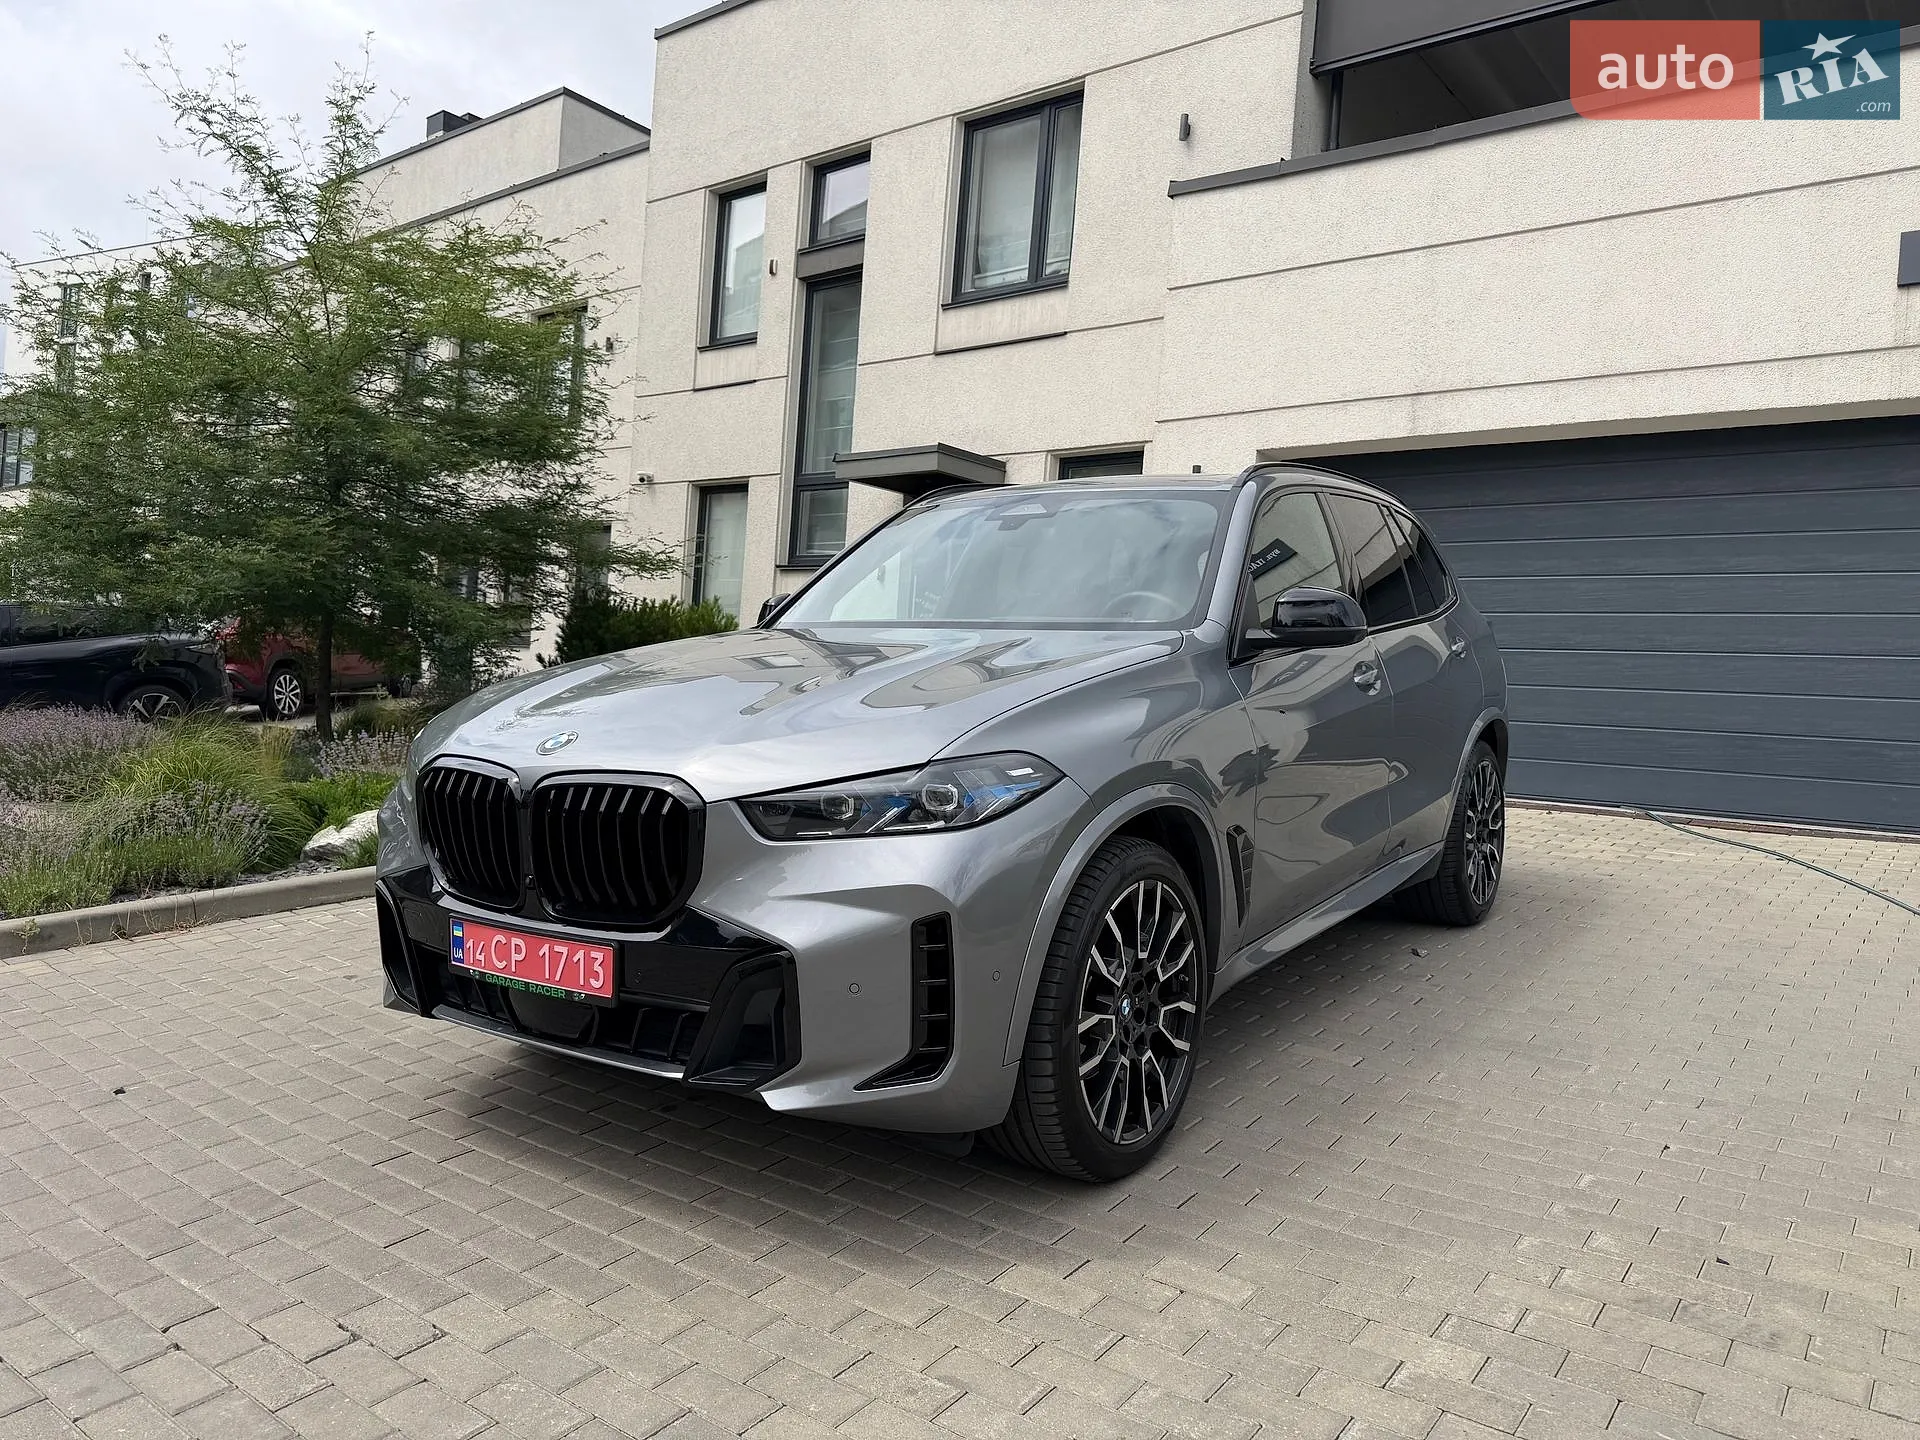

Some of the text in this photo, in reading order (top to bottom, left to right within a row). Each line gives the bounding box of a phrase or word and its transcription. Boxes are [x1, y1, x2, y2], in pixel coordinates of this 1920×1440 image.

[453, 947, 464, 960] UA
[538, 943, 605, 989] 1713
[485, 973, 567, 999] GARAGE RACER
